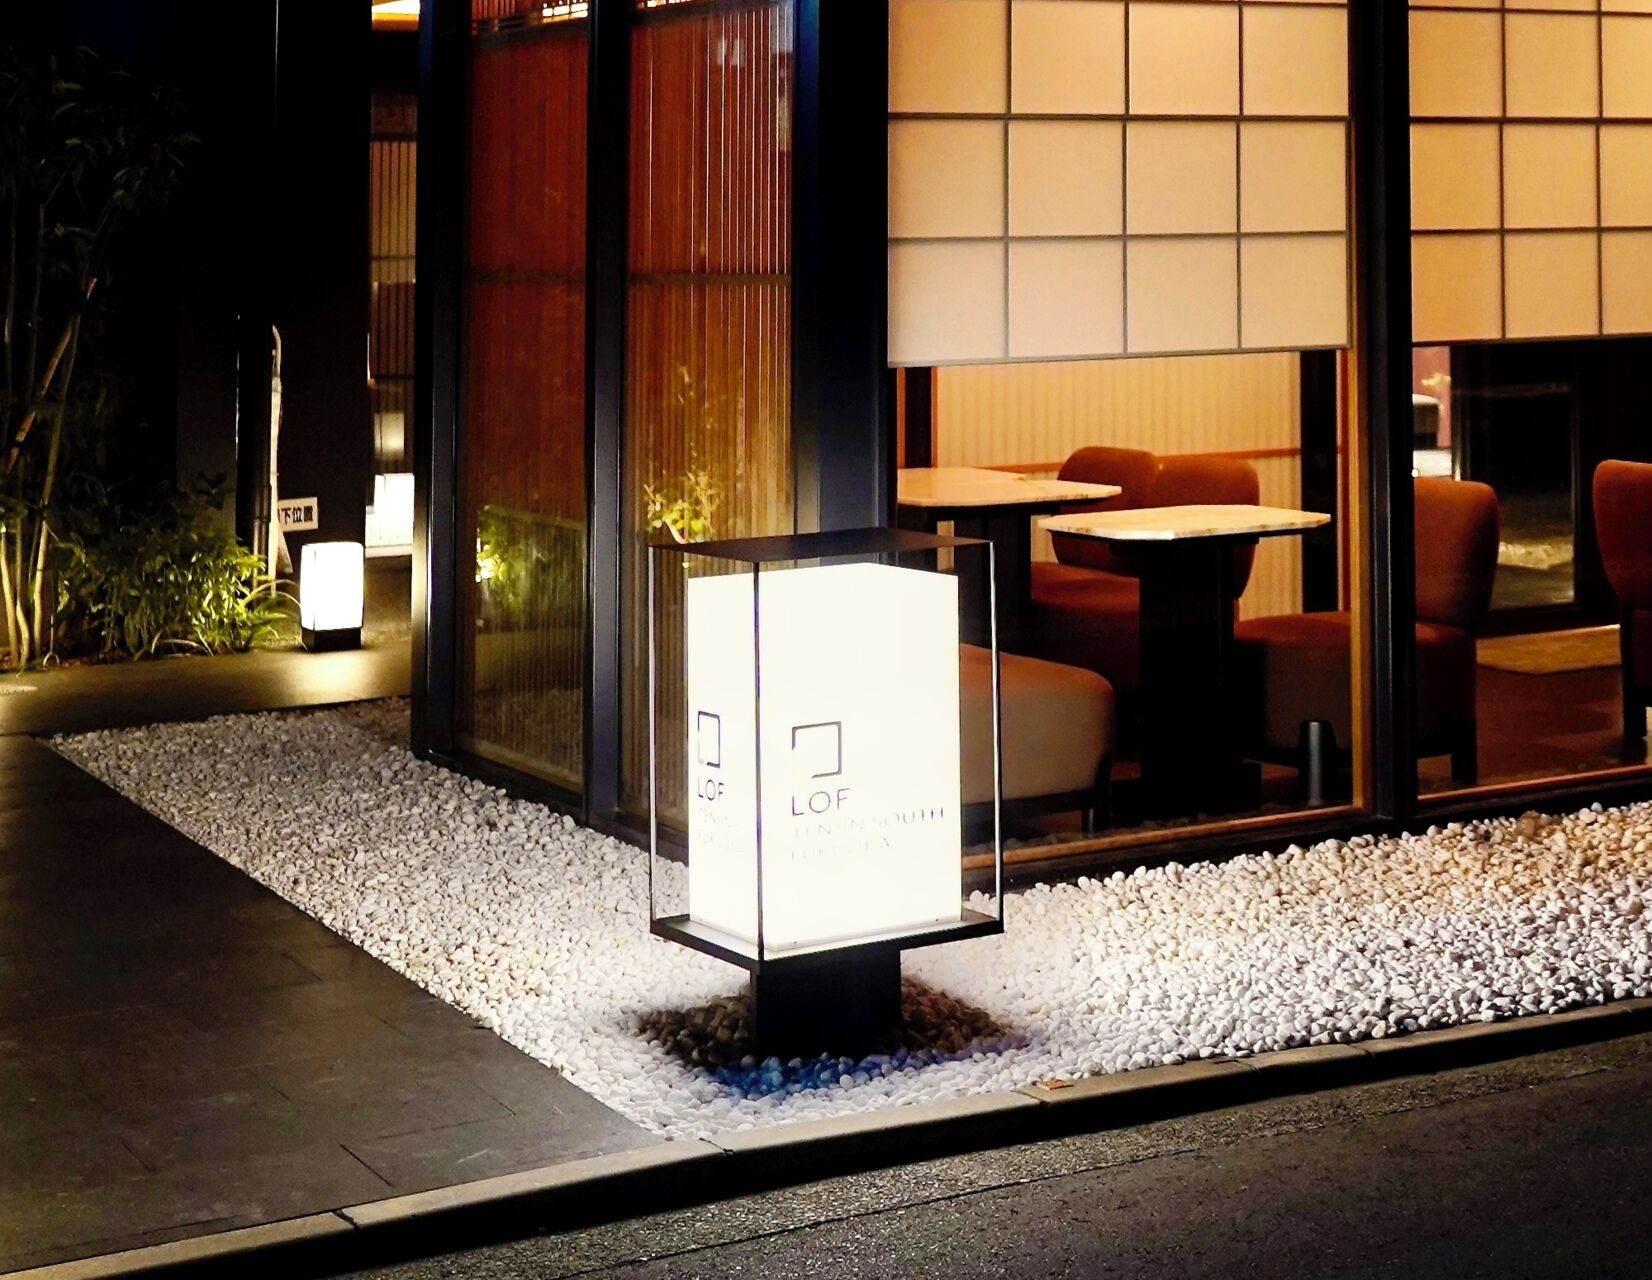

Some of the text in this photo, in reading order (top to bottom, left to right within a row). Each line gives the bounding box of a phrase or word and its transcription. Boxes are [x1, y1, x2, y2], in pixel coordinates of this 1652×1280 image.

[277, 505, 314, 525] 下位置
[697, 775, 725, 803] LOF
[792, 787, 850, 816] LOF
